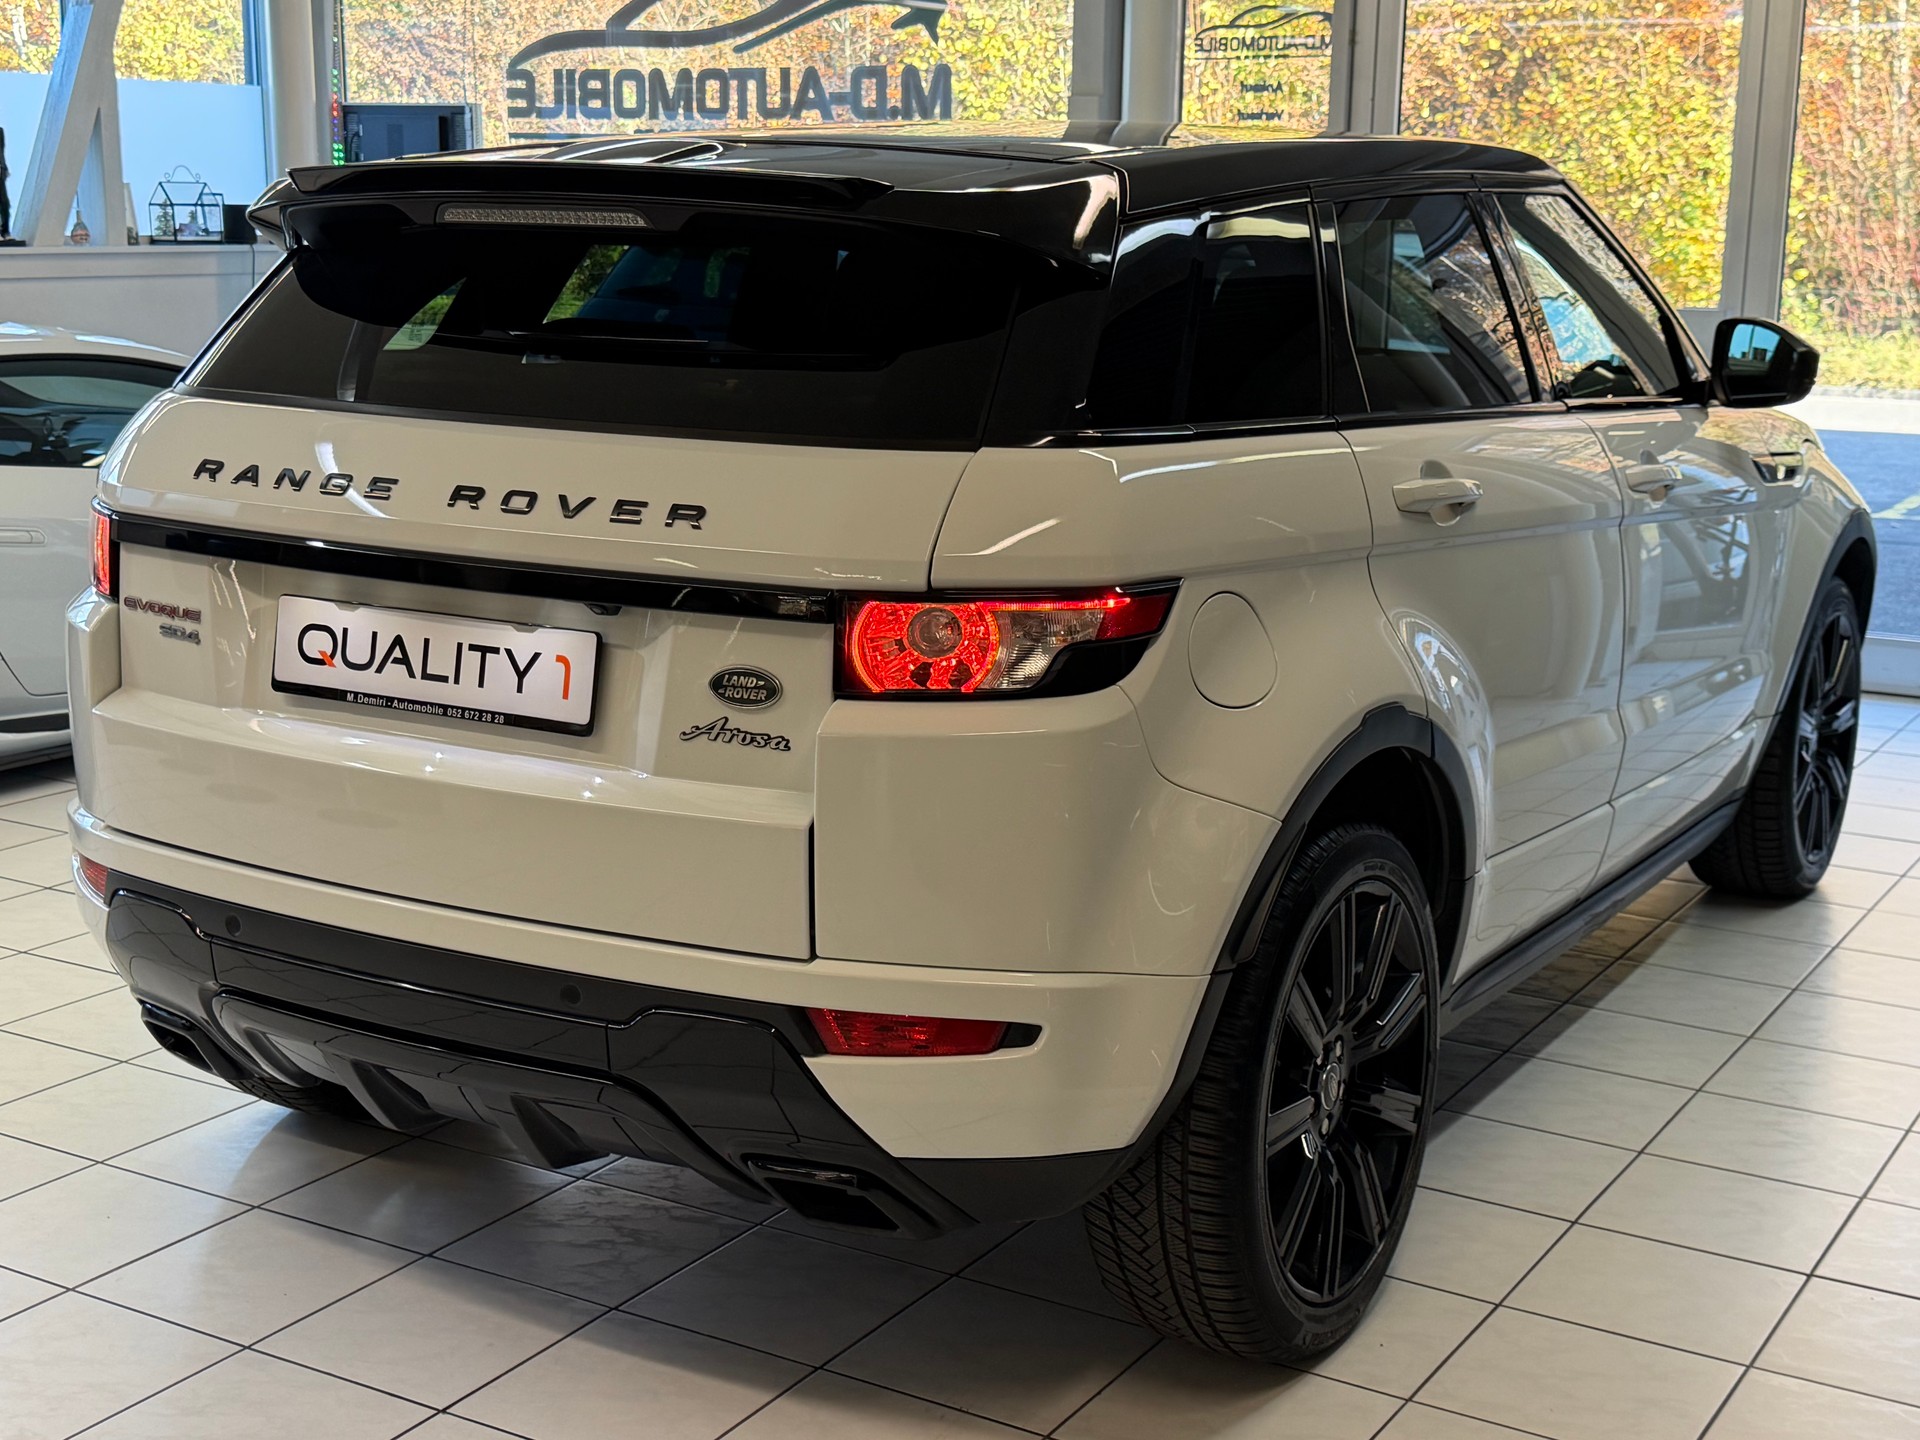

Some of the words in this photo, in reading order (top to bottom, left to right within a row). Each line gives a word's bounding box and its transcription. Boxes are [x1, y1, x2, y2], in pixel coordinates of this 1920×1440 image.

[192, 458, 400, 501] RANGE
[446, 484, 708, 531] ROVER
[159, 623, 202, 646] SD4
[297, 622, 542, 694] QUALITY
[724, 687, 768, 700] ROVER
[392, 699, 444, 715] Automobile
[447, 707, 462, 718] 052
[464, 710, 479, 720] 672
[481, 712, 492, 722] 28
[494, 714, 505, 724] 28
[679, 716, 791, 751] Arosa
